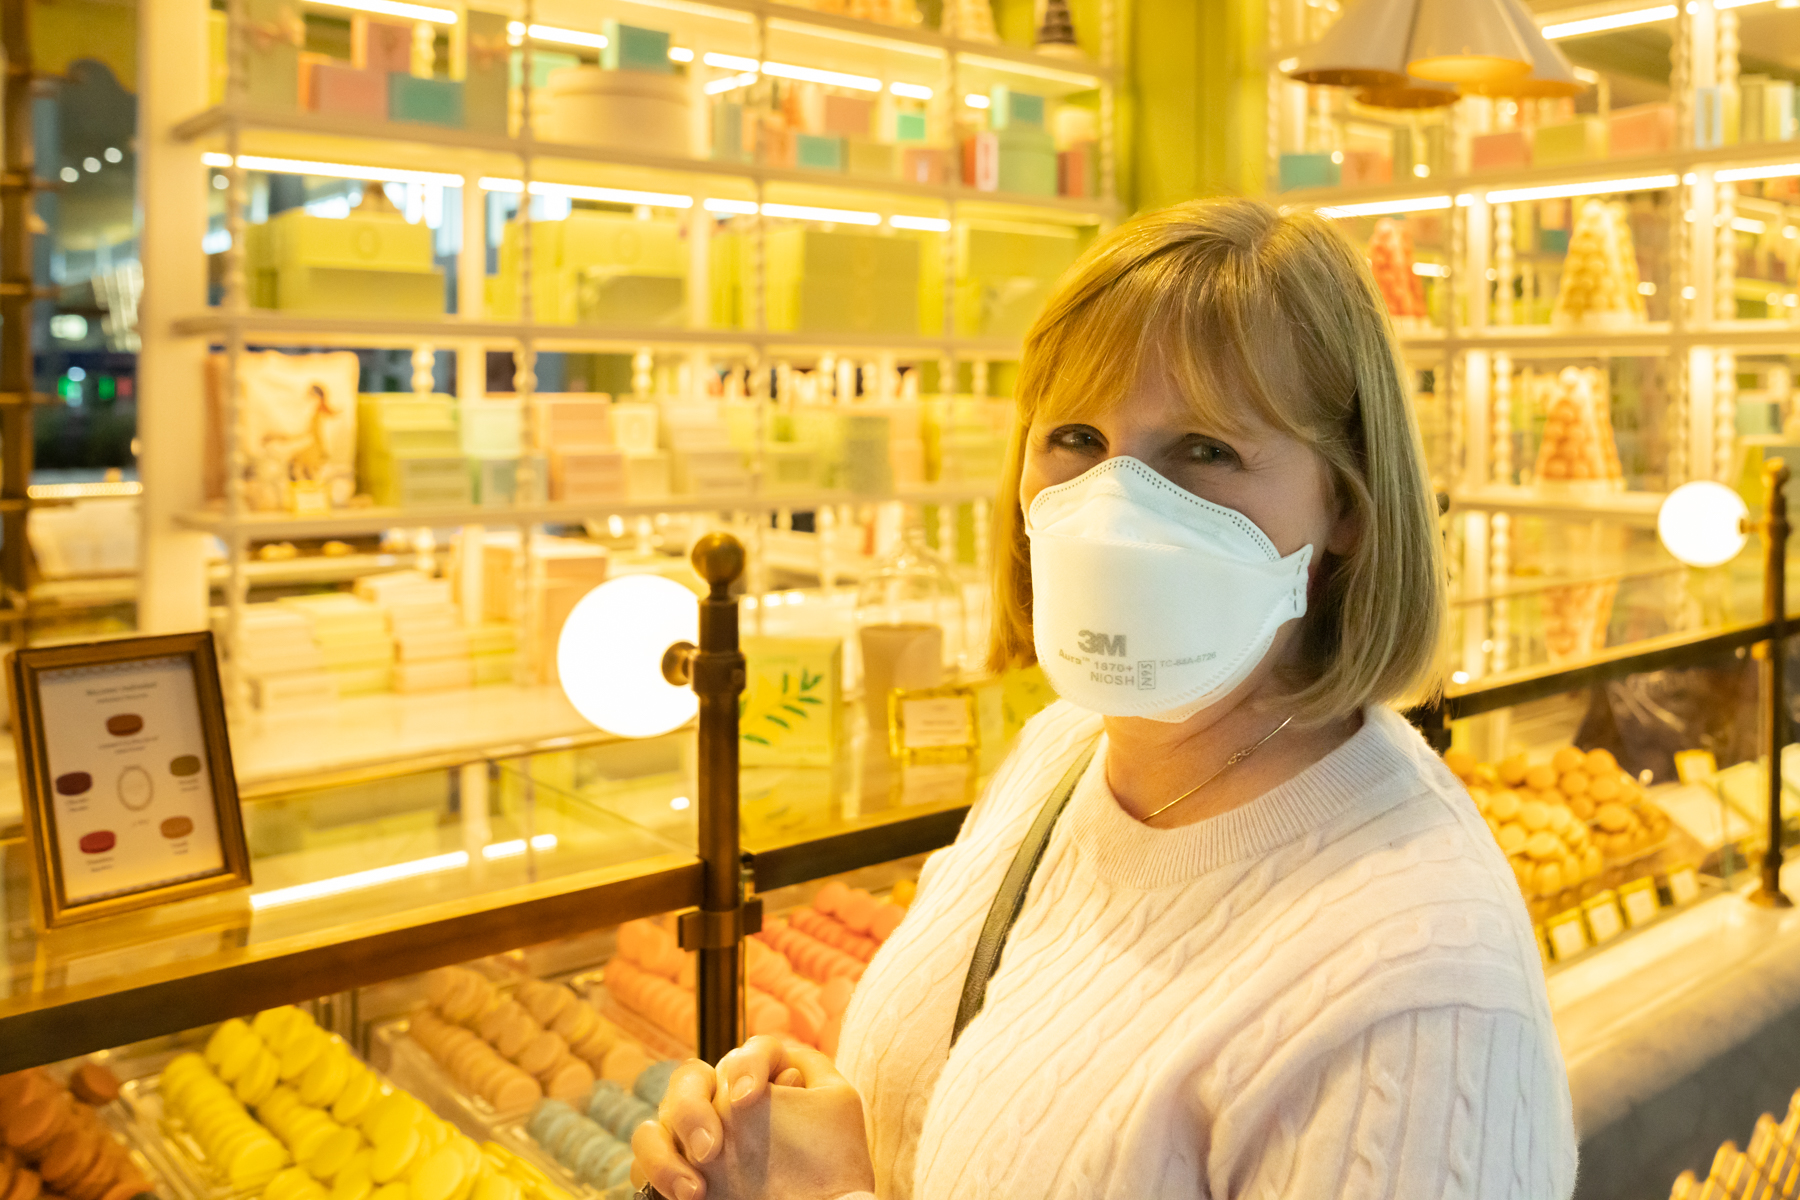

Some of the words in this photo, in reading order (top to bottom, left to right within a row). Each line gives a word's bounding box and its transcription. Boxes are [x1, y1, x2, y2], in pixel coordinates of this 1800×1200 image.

[1077, 629, 1127, 657] 3M
[1093, 661, 1133, 673] 1870+
[1140, 662, 1153, 687] N95
[1090, 671, 1135, 686] NIOSH
